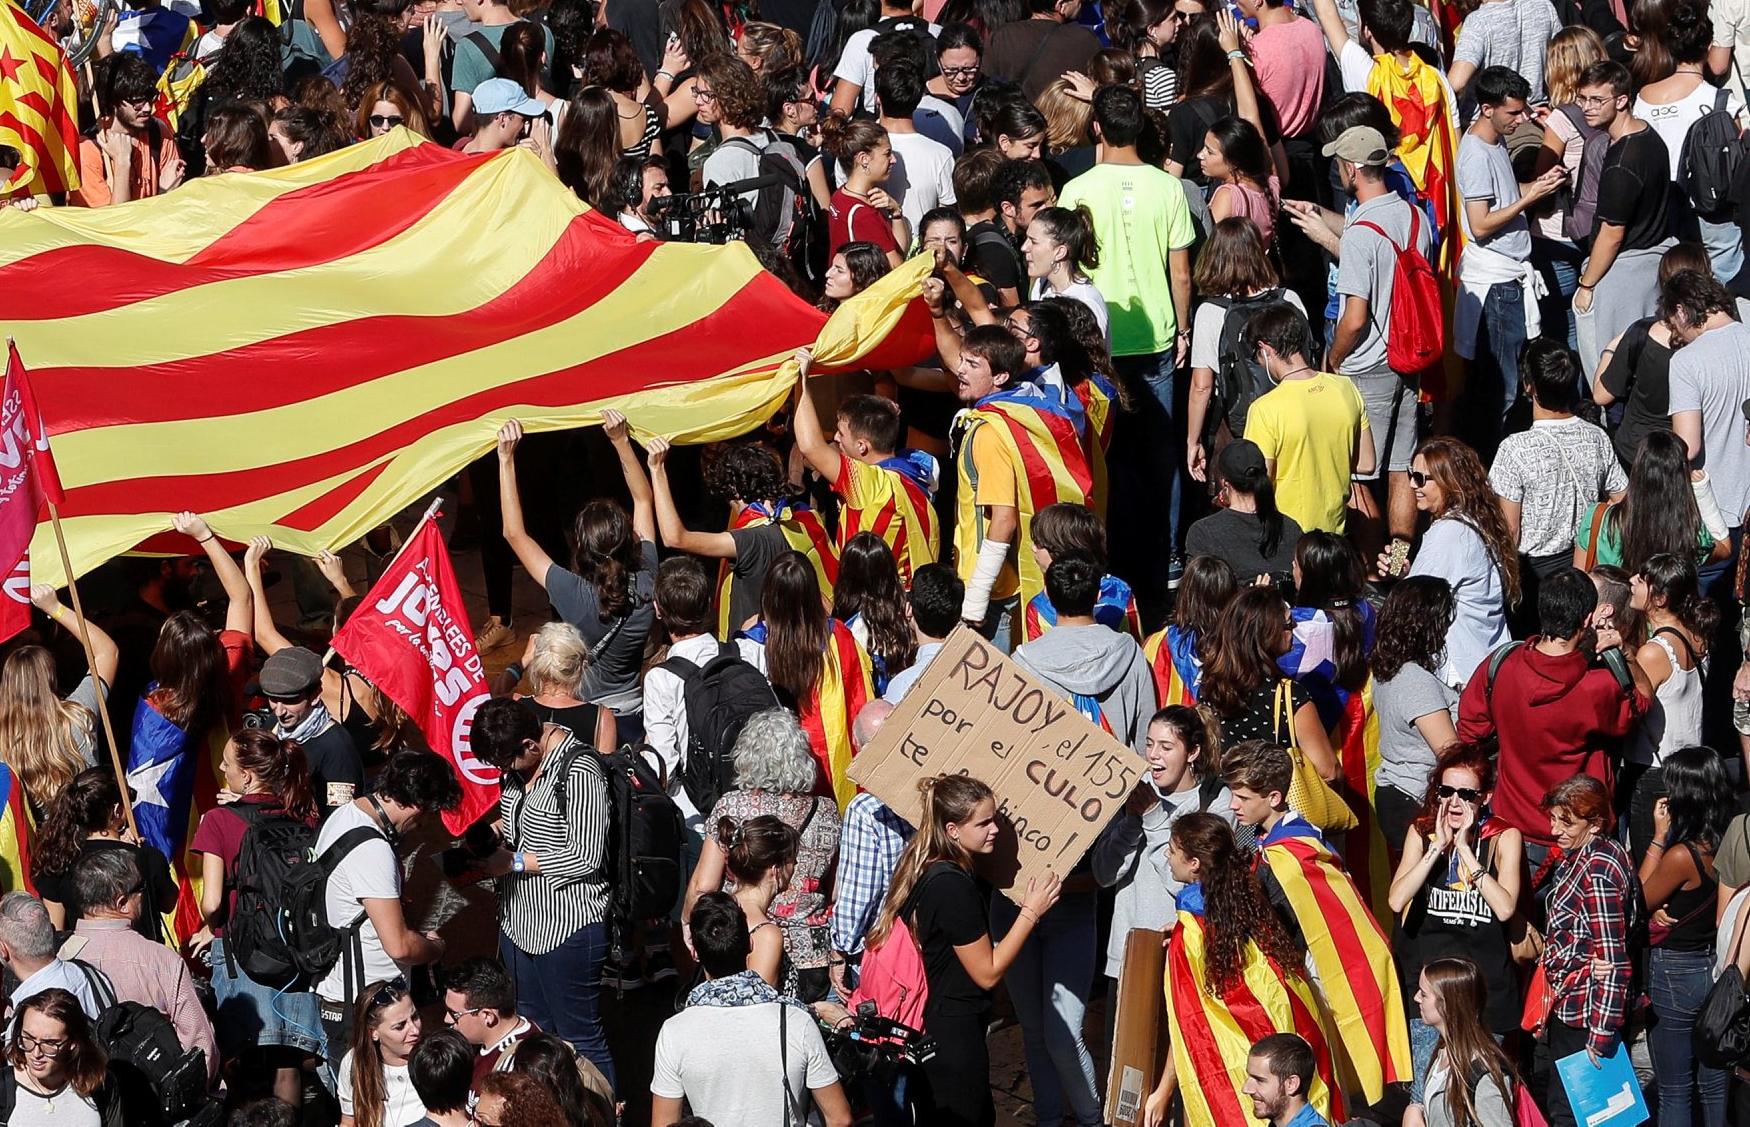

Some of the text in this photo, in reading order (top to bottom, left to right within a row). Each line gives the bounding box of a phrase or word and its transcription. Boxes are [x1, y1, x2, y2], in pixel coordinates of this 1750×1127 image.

[463, 654, 485, 684] DE
[900, 733, 929, 767] te
[920, 699, 1103, 823] por el CULO
[1055, 733, 1089, 761] el
[1082, 749, 1136, 799] 155
